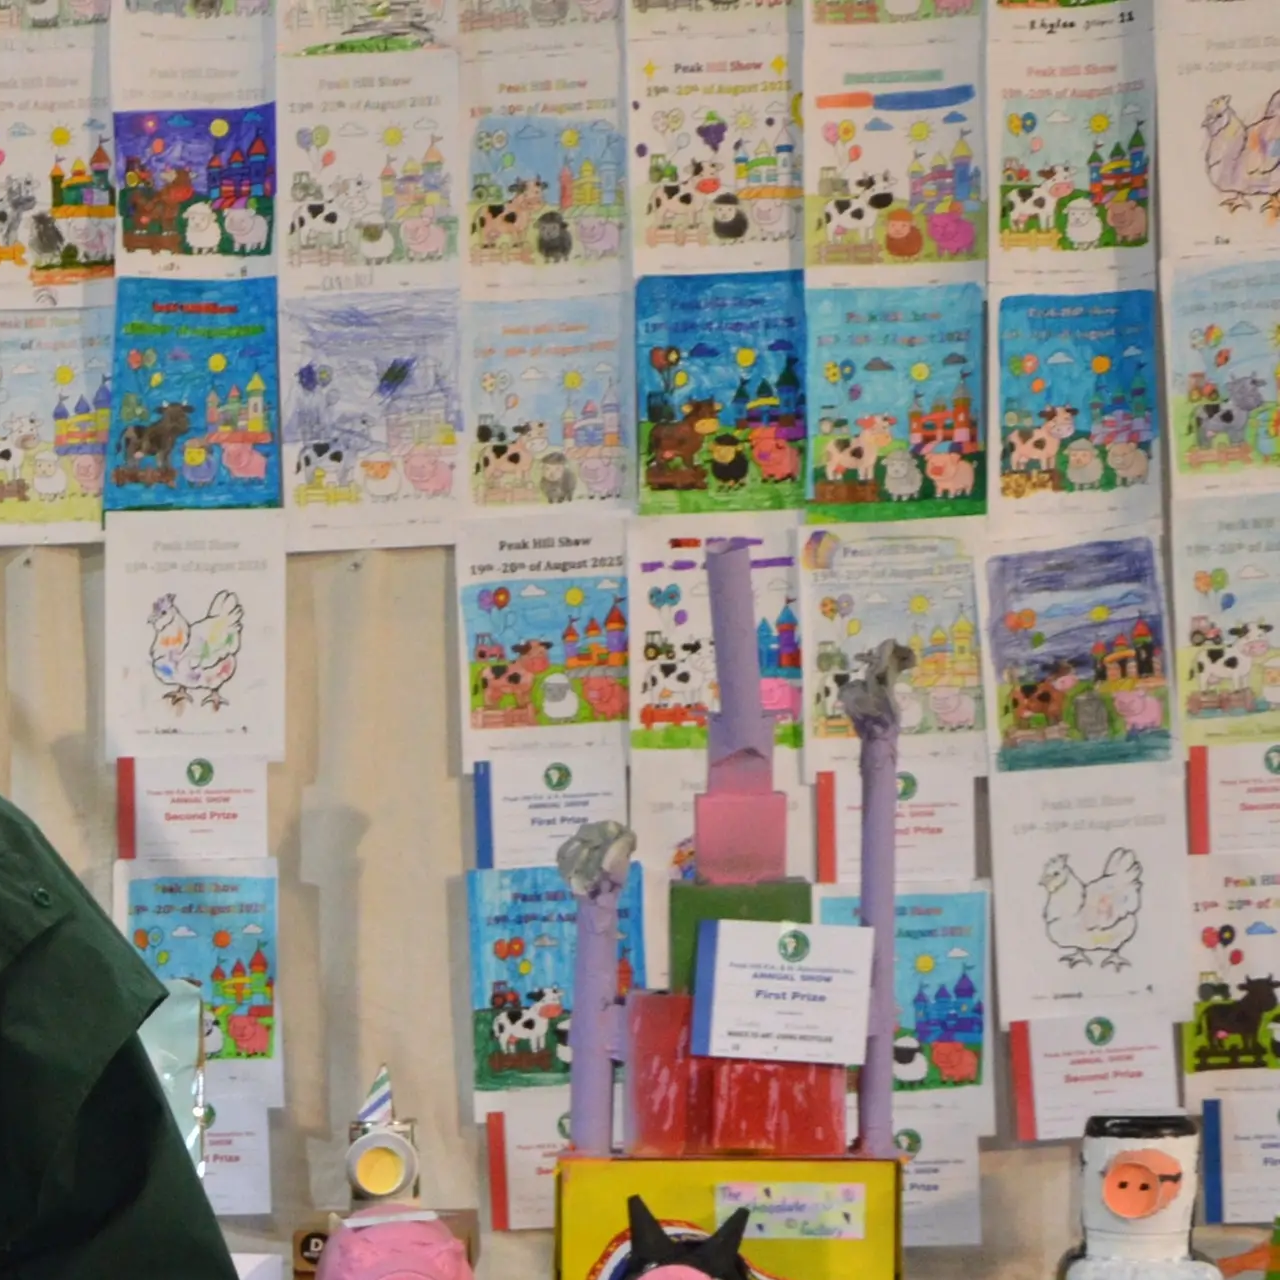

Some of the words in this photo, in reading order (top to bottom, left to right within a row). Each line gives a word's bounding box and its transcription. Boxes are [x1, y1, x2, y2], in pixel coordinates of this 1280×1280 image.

[499, 540, 529, 551] Peak
[533, 538, 555, 549] Hill
[558, 537, 592, 548] Show
[544, 559, 587, 573] August
[165, 812, 206, 821] Second
[209, 811, 238, 820] Prize
[755, 990, 787, 1001] First
[791, 992, 826, 1002] Prize
[1064, 1073, 1109, 1083] Second
[1112, 1069, 1143, 1079] Prize
